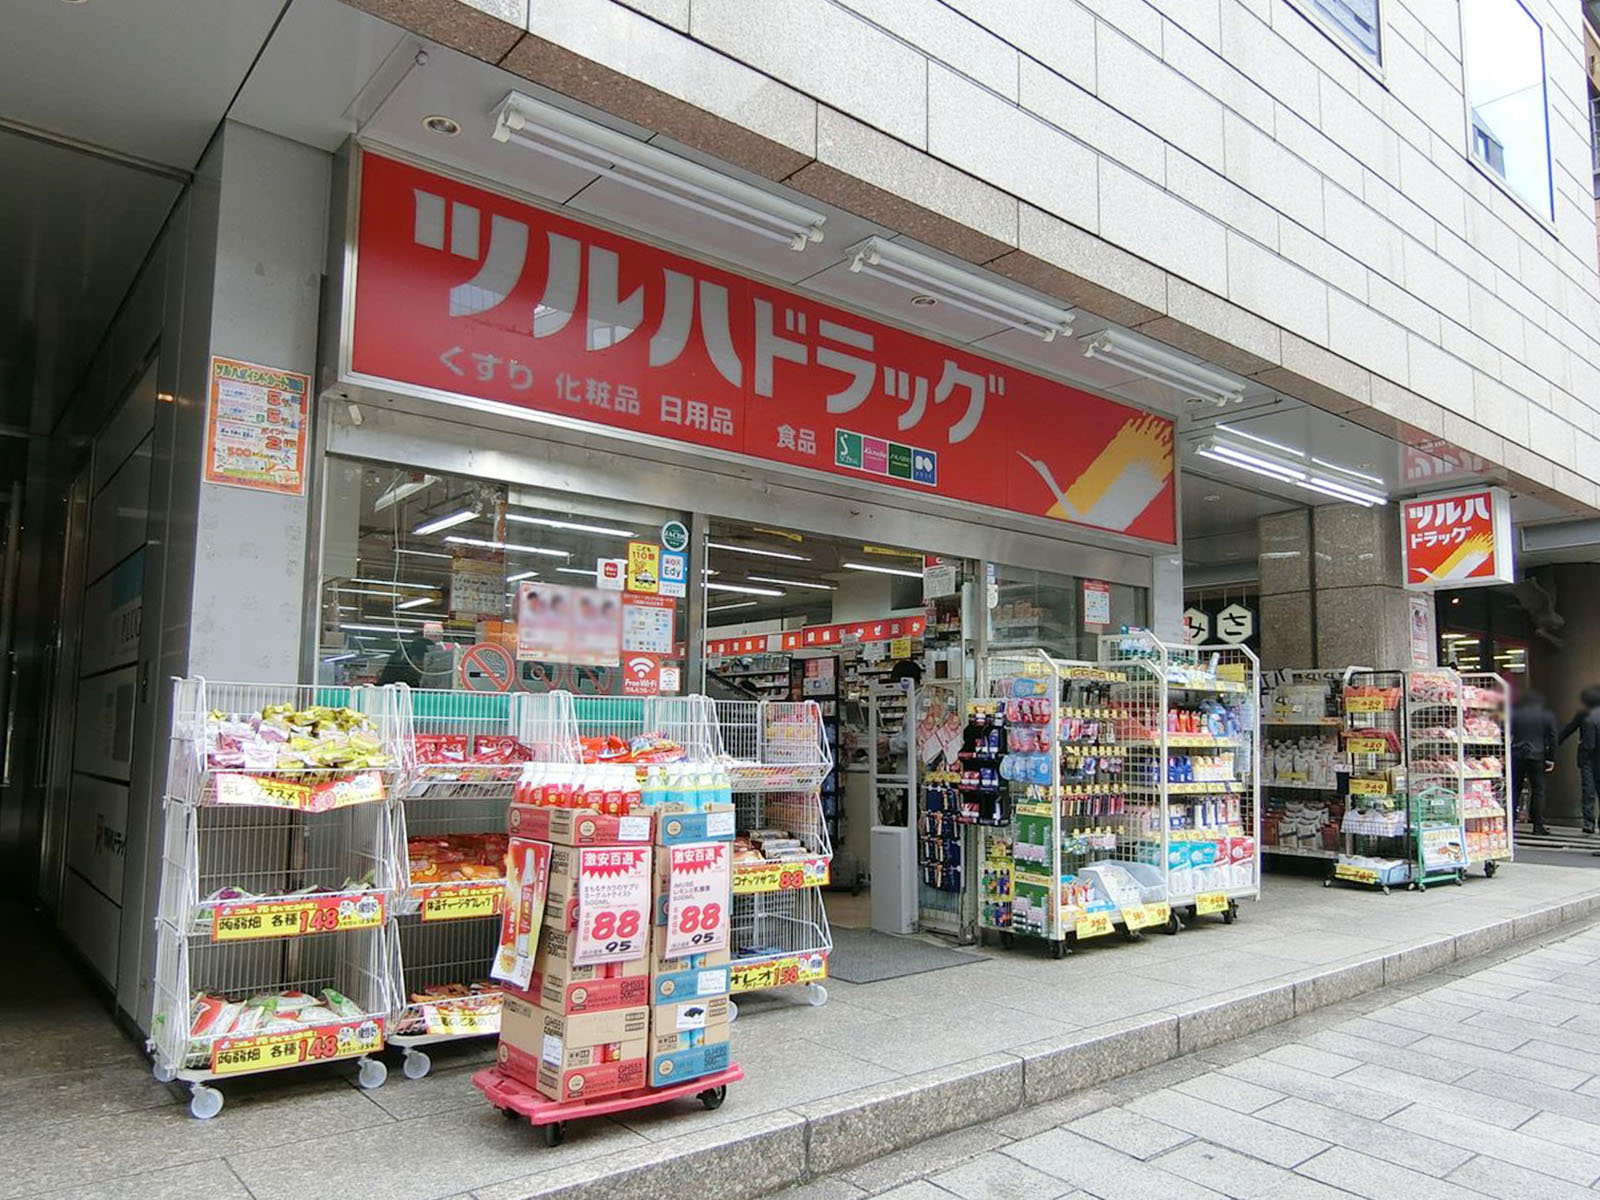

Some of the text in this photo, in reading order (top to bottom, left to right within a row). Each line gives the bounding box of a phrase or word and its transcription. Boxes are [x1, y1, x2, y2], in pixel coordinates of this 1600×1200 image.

[413, 189, 1005, 444] ツルハドラッグ
[439, 345, 817, 456] くすり 化粧品 日用品 食品
[1409, 497, 1490, 529] ツルハ
[1411, 525, 1473, 549] ドラッグ
[779, 869, 804, 889] 88
[271, 912, 297, 927] 各種
[299, 907, 339, 933] 148
[591, 909, 641, 941] 88
[679, 902, 721, 933] 88
[605, 940, 632, 953] 95
[691, 932, 714, 944] 95
[270, 1043, 297, 1058] 各種
[298, 1035, 338, 1062] 148
